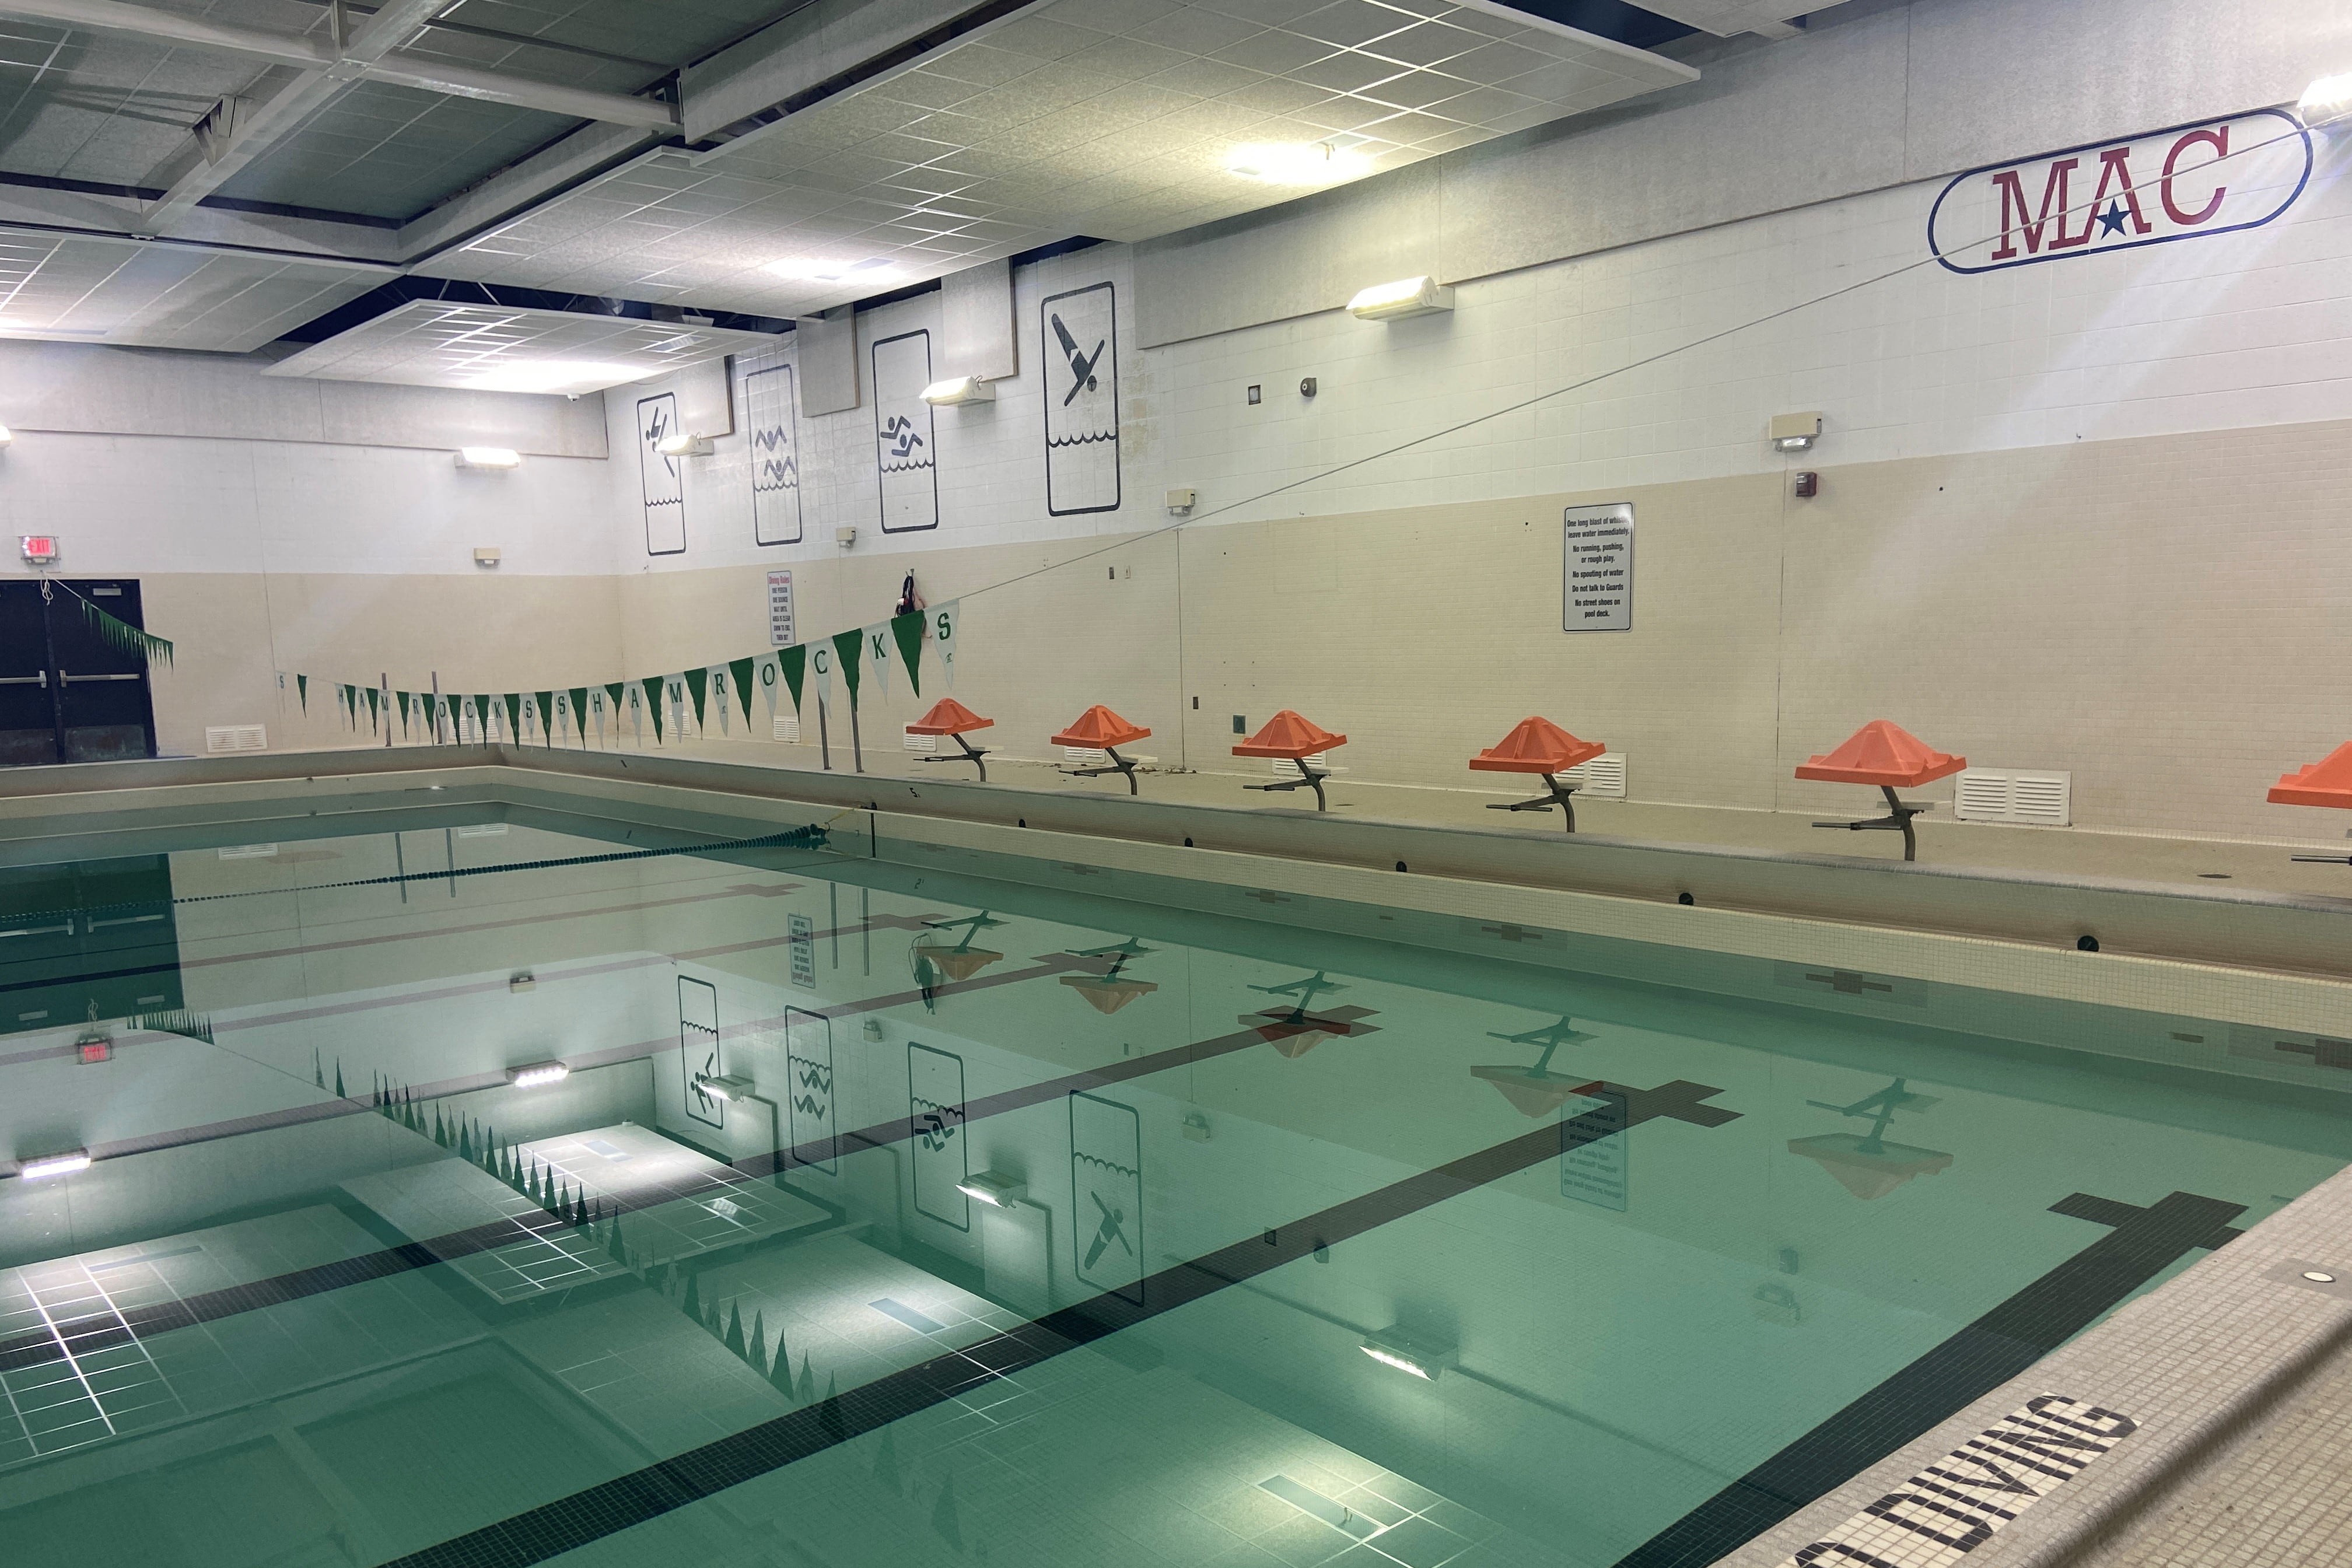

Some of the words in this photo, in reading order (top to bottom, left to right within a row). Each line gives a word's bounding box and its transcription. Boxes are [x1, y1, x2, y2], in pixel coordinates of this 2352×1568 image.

[1992, 125, 2229, 260] MAC
[1578, 519, 1588, 527] long
[1598, 528, 1629, 537] immediately.
[29, 538, 50, 554] EXIT
[1602, 542, 1623, 551] pushing,
[1581, 569, 1601, 578] spouting
[1864, 1395, 2137, 1553] DIVING
